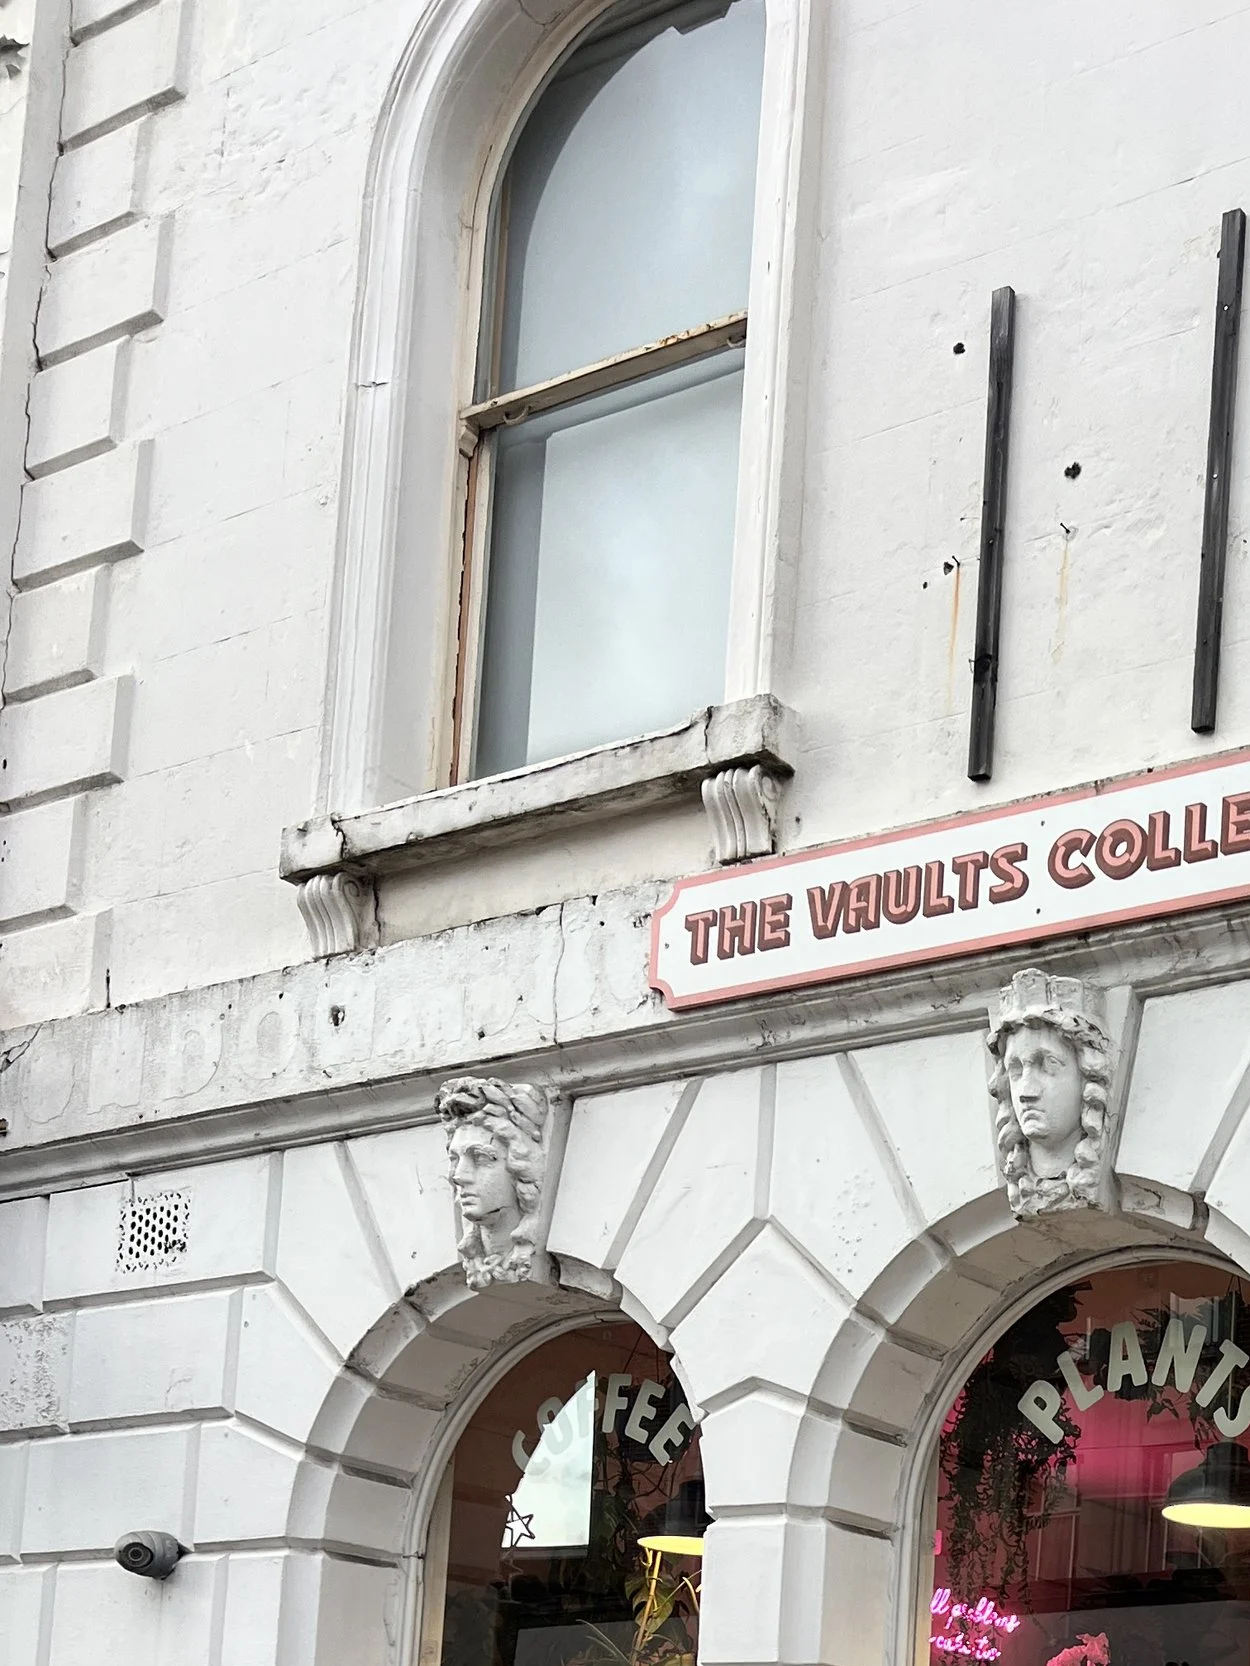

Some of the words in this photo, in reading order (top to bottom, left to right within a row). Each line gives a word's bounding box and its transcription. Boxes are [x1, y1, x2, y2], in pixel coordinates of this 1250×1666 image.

[684, 893, 791, 965] THE
[807, 842, 1028, 938] VAULTS
[511, 1372, 697, 1477] COFFEE
